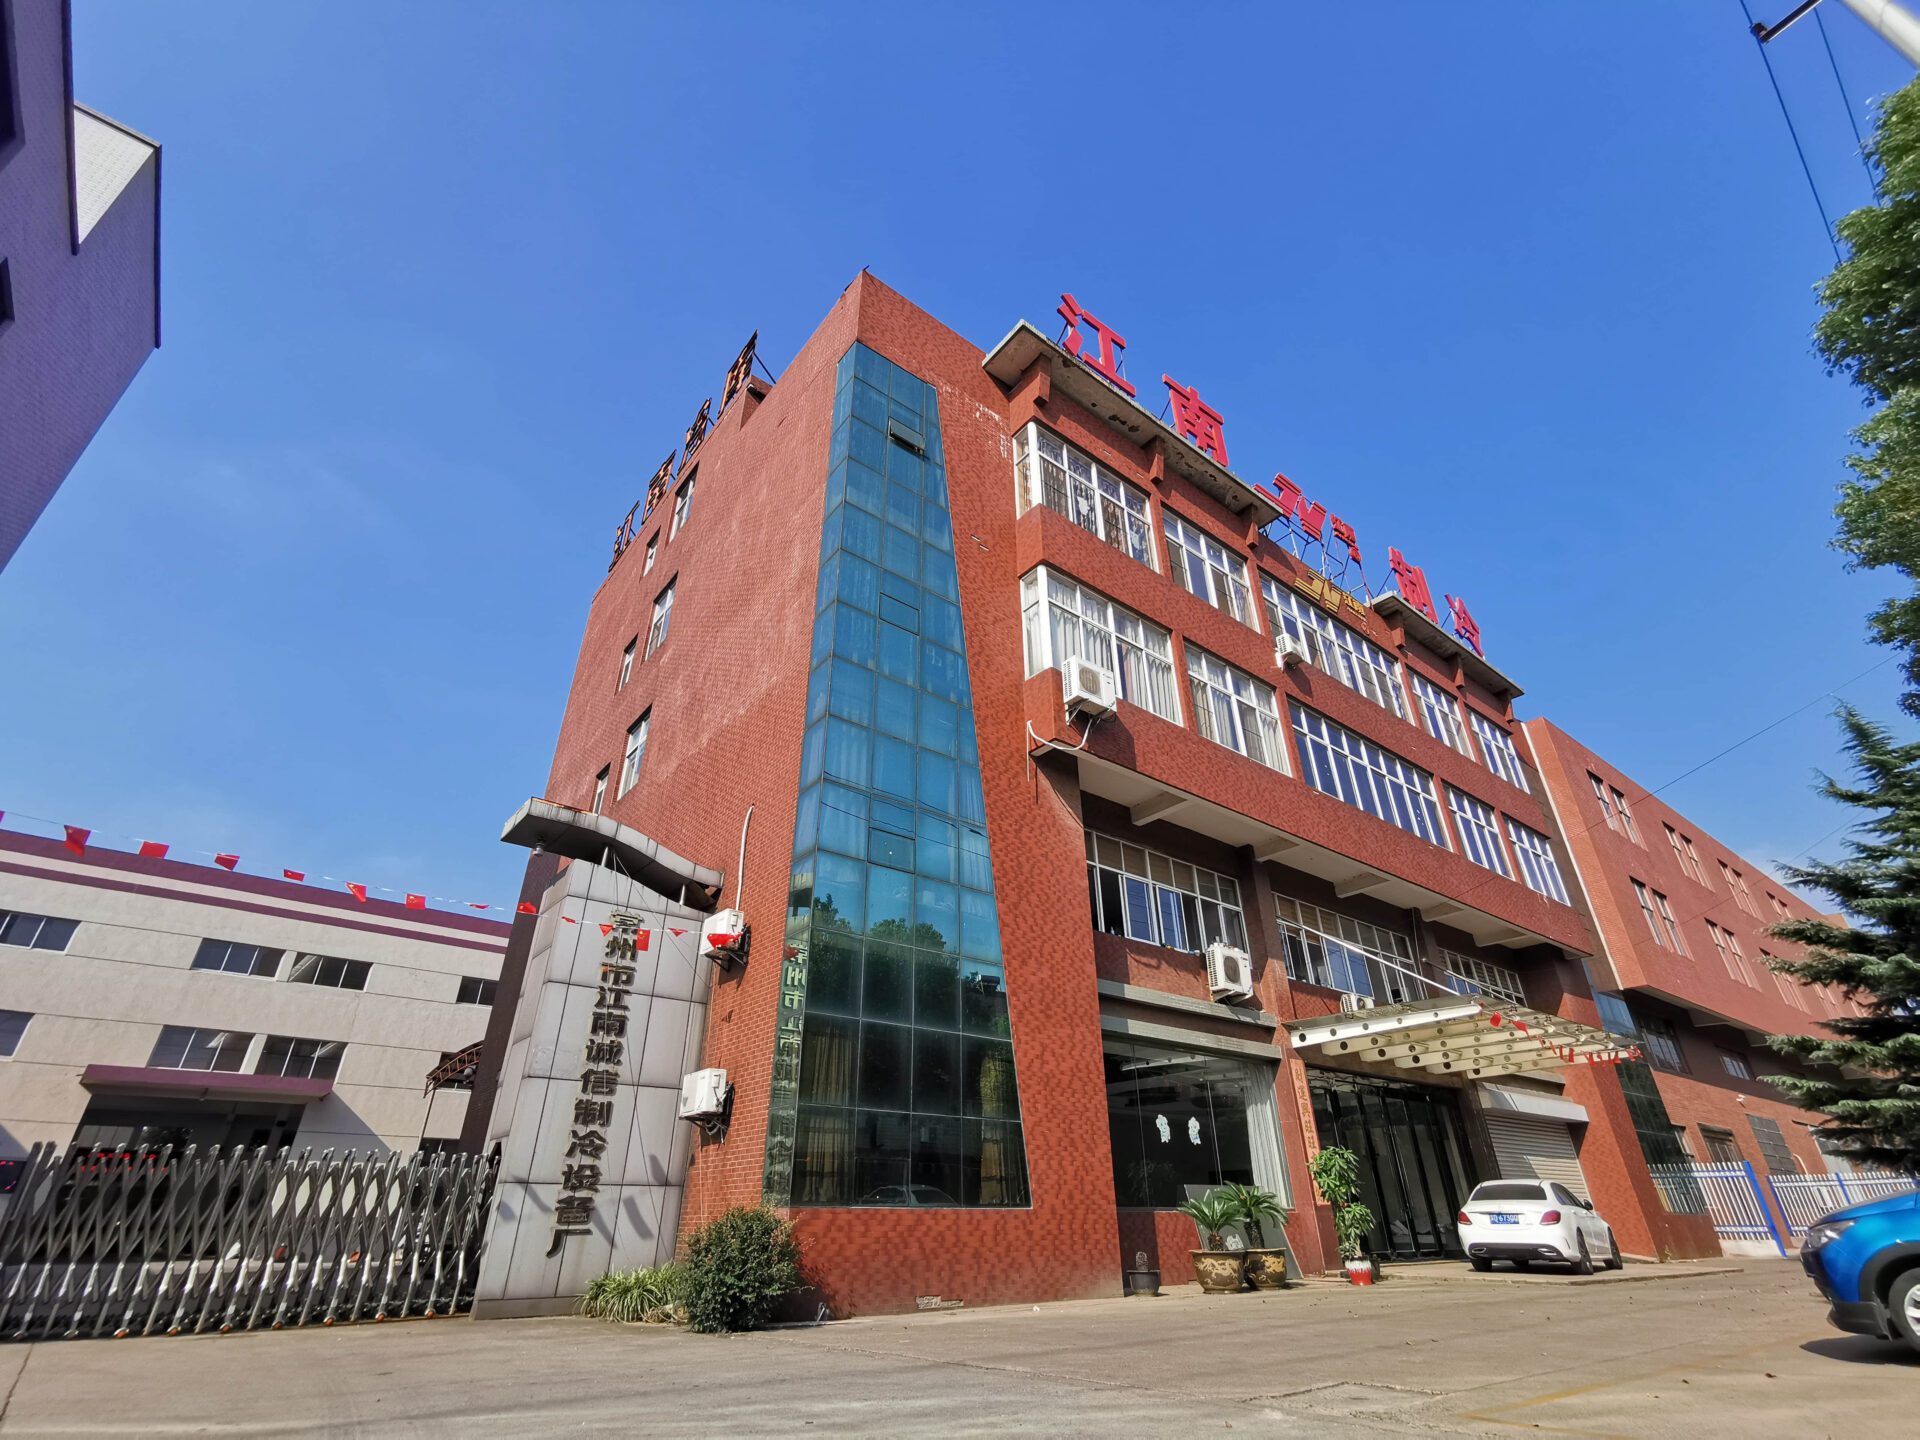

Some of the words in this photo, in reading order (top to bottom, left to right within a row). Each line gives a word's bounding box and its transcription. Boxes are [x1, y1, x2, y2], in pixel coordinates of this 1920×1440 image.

[1057, 293, 1229, 467] 江南
[1388, 546, 1484, 657] 制冷
[546, 910, 645, 1259] 常州市江南诚信制冷设备厂
